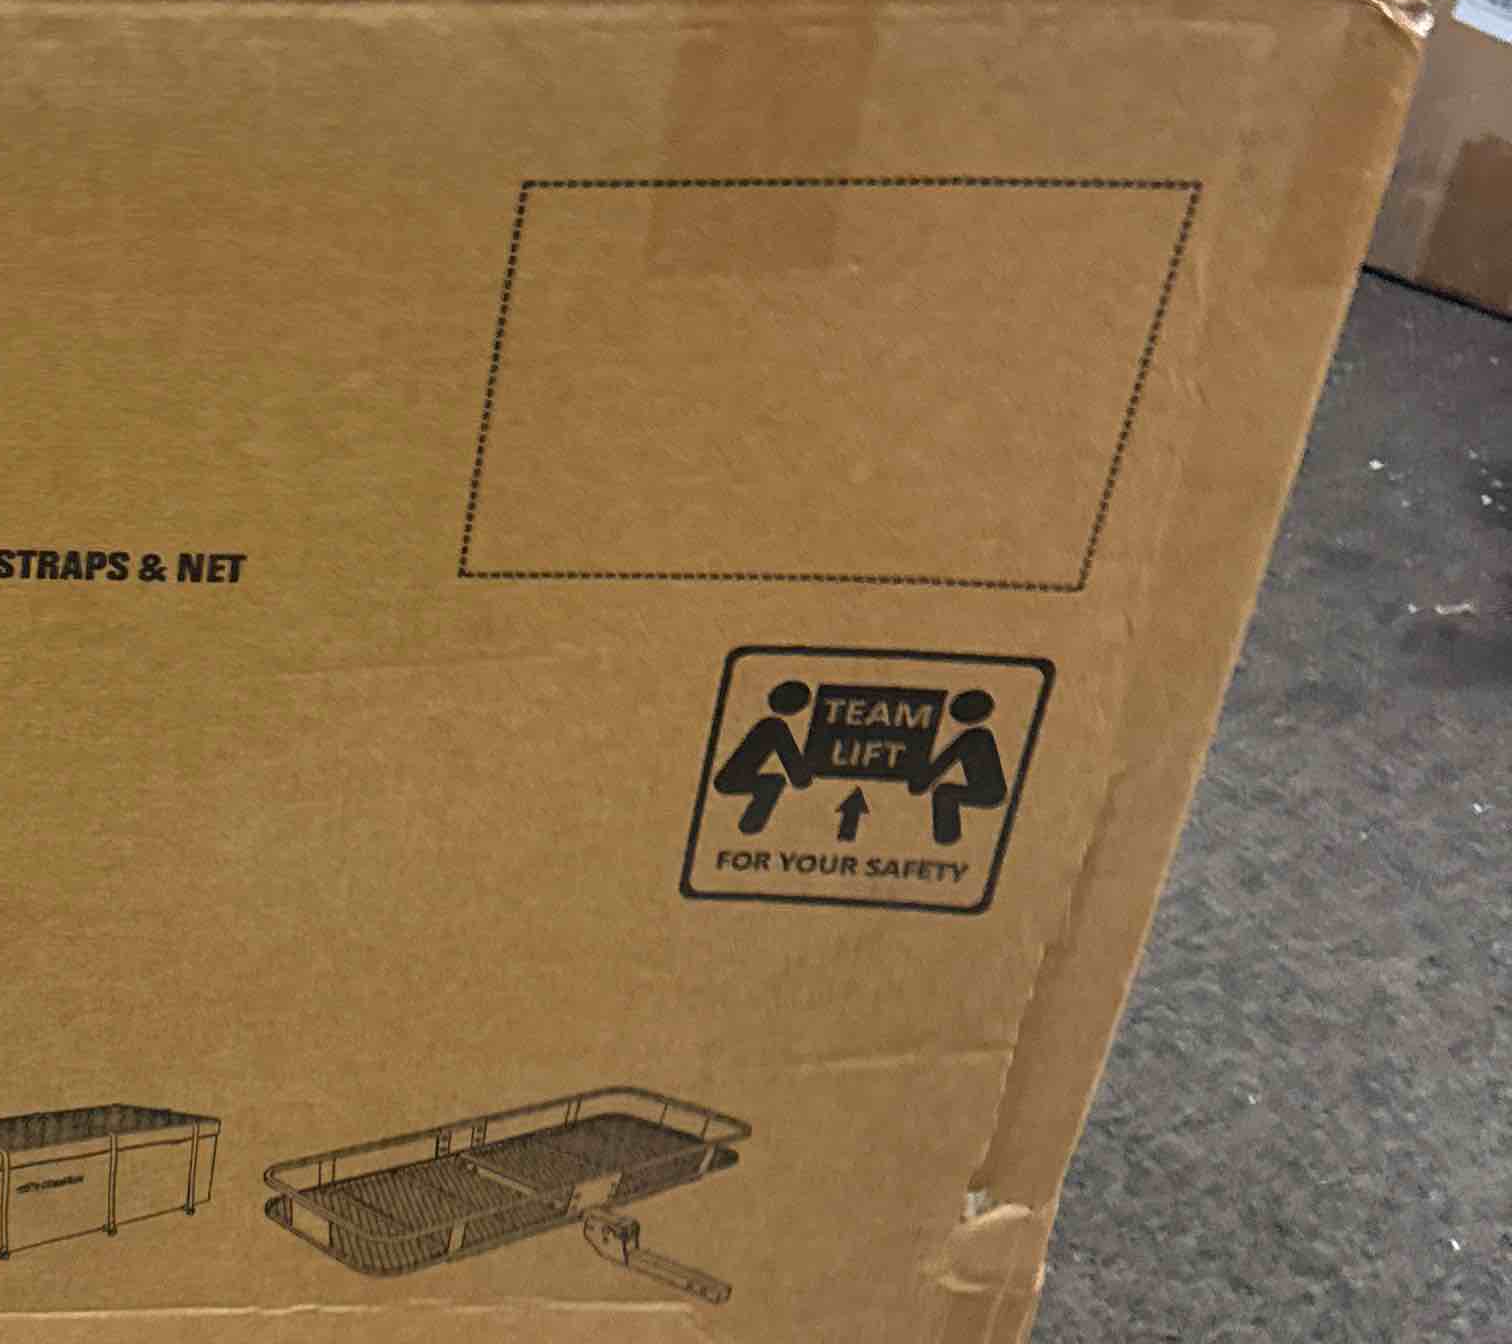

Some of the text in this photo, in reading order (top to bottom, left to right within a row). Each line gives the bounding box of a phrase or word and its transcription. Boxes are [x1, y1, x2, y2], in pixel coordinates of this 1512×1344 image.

[138, 553, 167, 583] &
[177, 553, 247, 584] NET
[825, 697, 933, 729] TEAM
[832, 739, 906, 769] LIFT
[716, 850, 969, 883] FOR YOUR SAFETY
